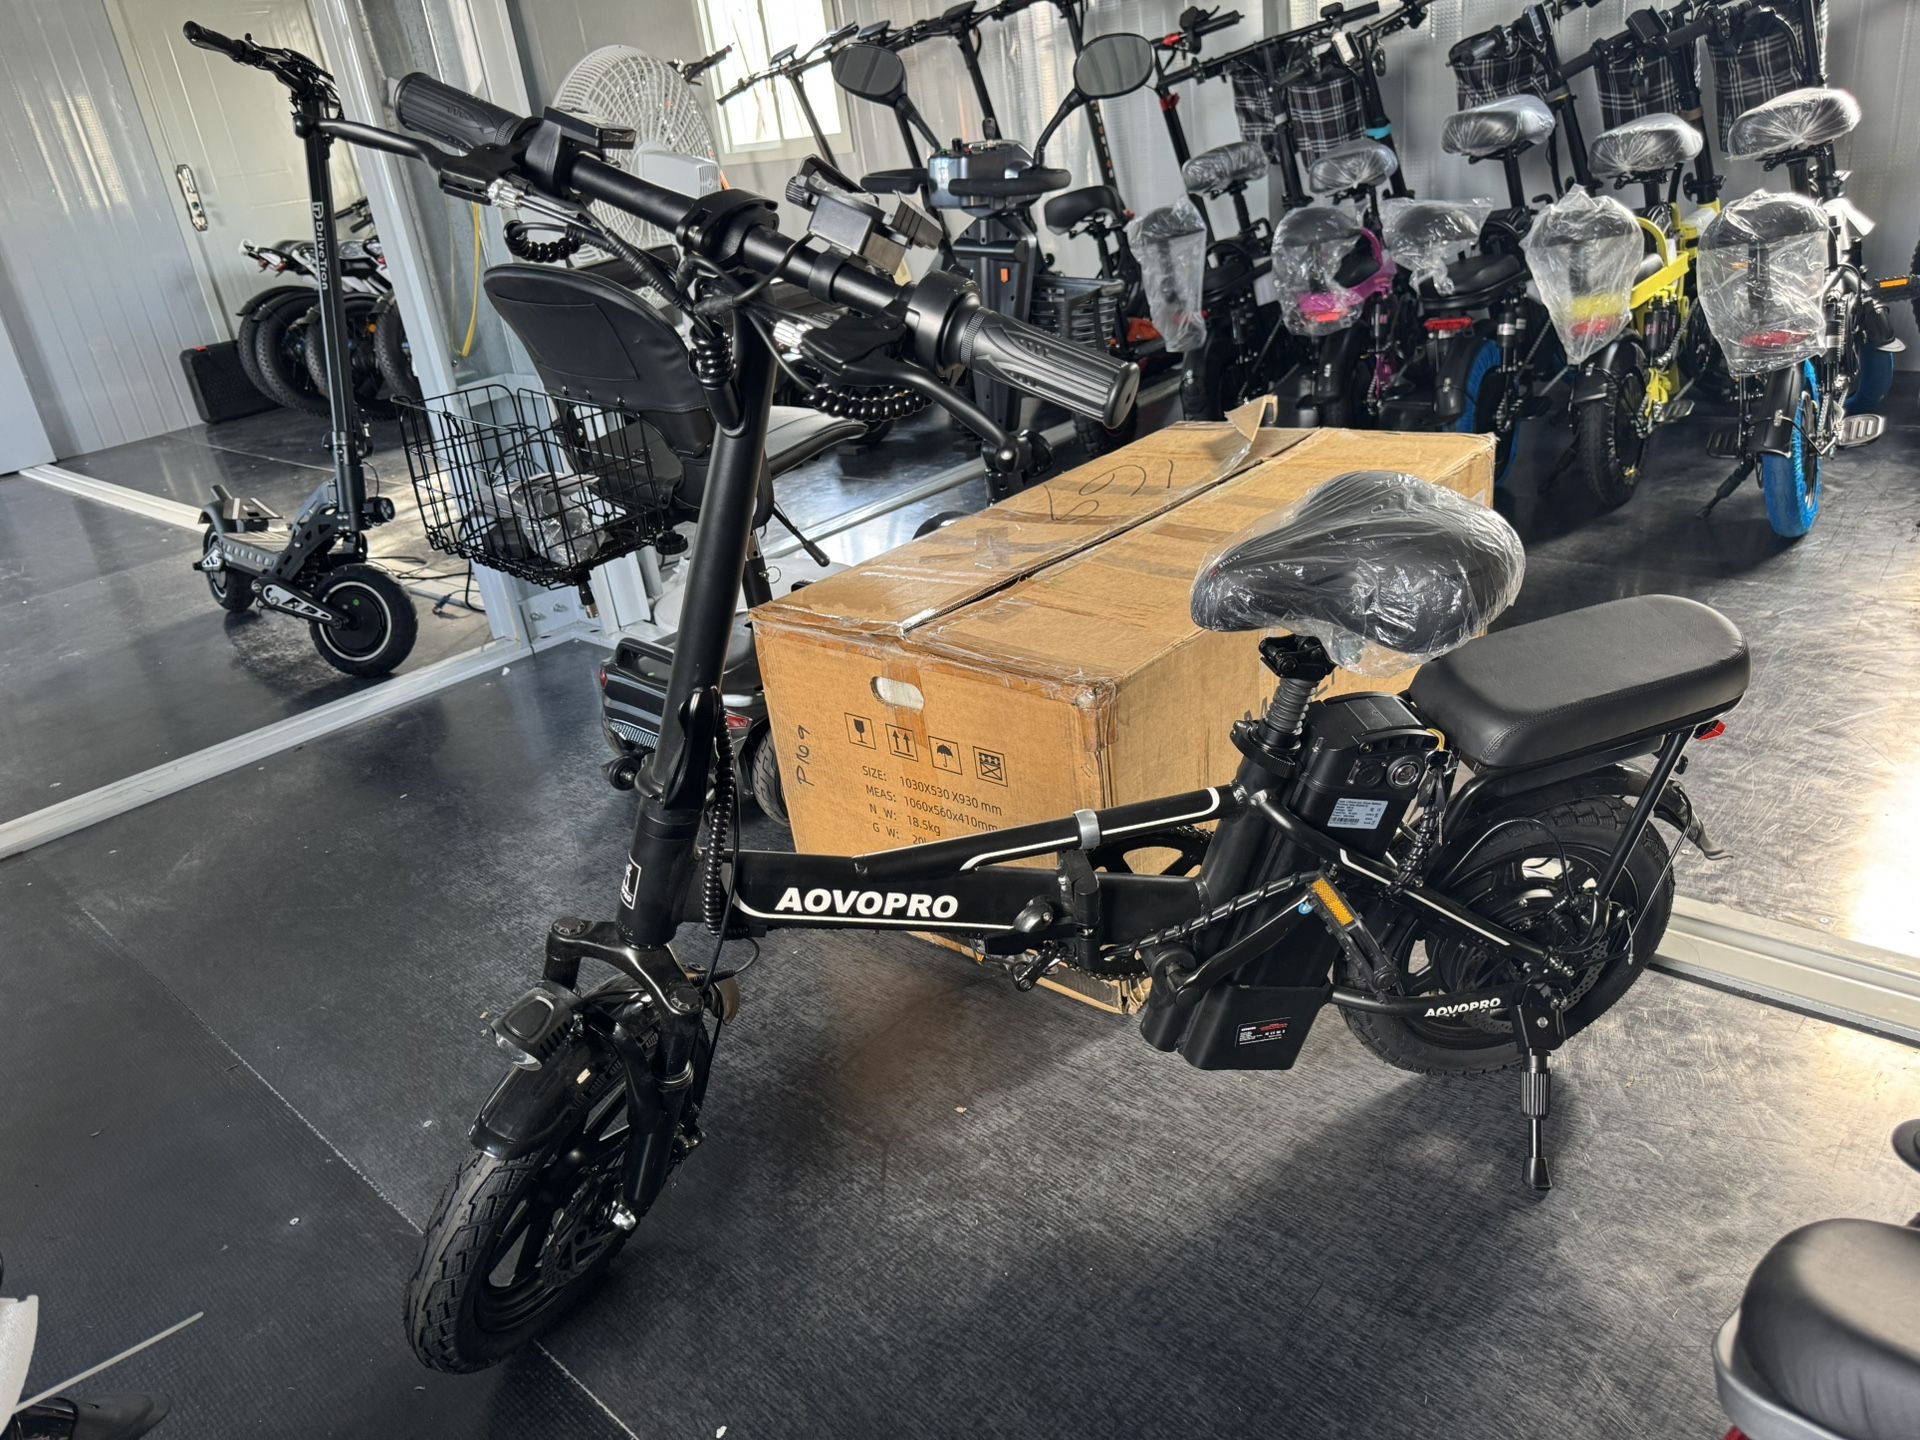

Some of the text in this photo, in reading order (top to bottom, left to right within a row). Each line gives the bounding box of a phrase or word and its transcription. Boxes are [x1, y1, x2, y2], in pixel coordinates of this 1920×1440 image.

[316, 221, 328, 290] DriveTron
[862, 765, 1003, 816] SIZE: 1030X530 X930 mm
[865, 784, 998, 831] MEAS: 1060x560x410mm
[869, 802, 897, 821] N W:
[872, 822, 900, 839] G W:
[907, 815, 941, 836] 18.5kg
[774, 886, 959, 919] AOVOPRO
[1423, 997, 1501, 1018] AOVOPRO
